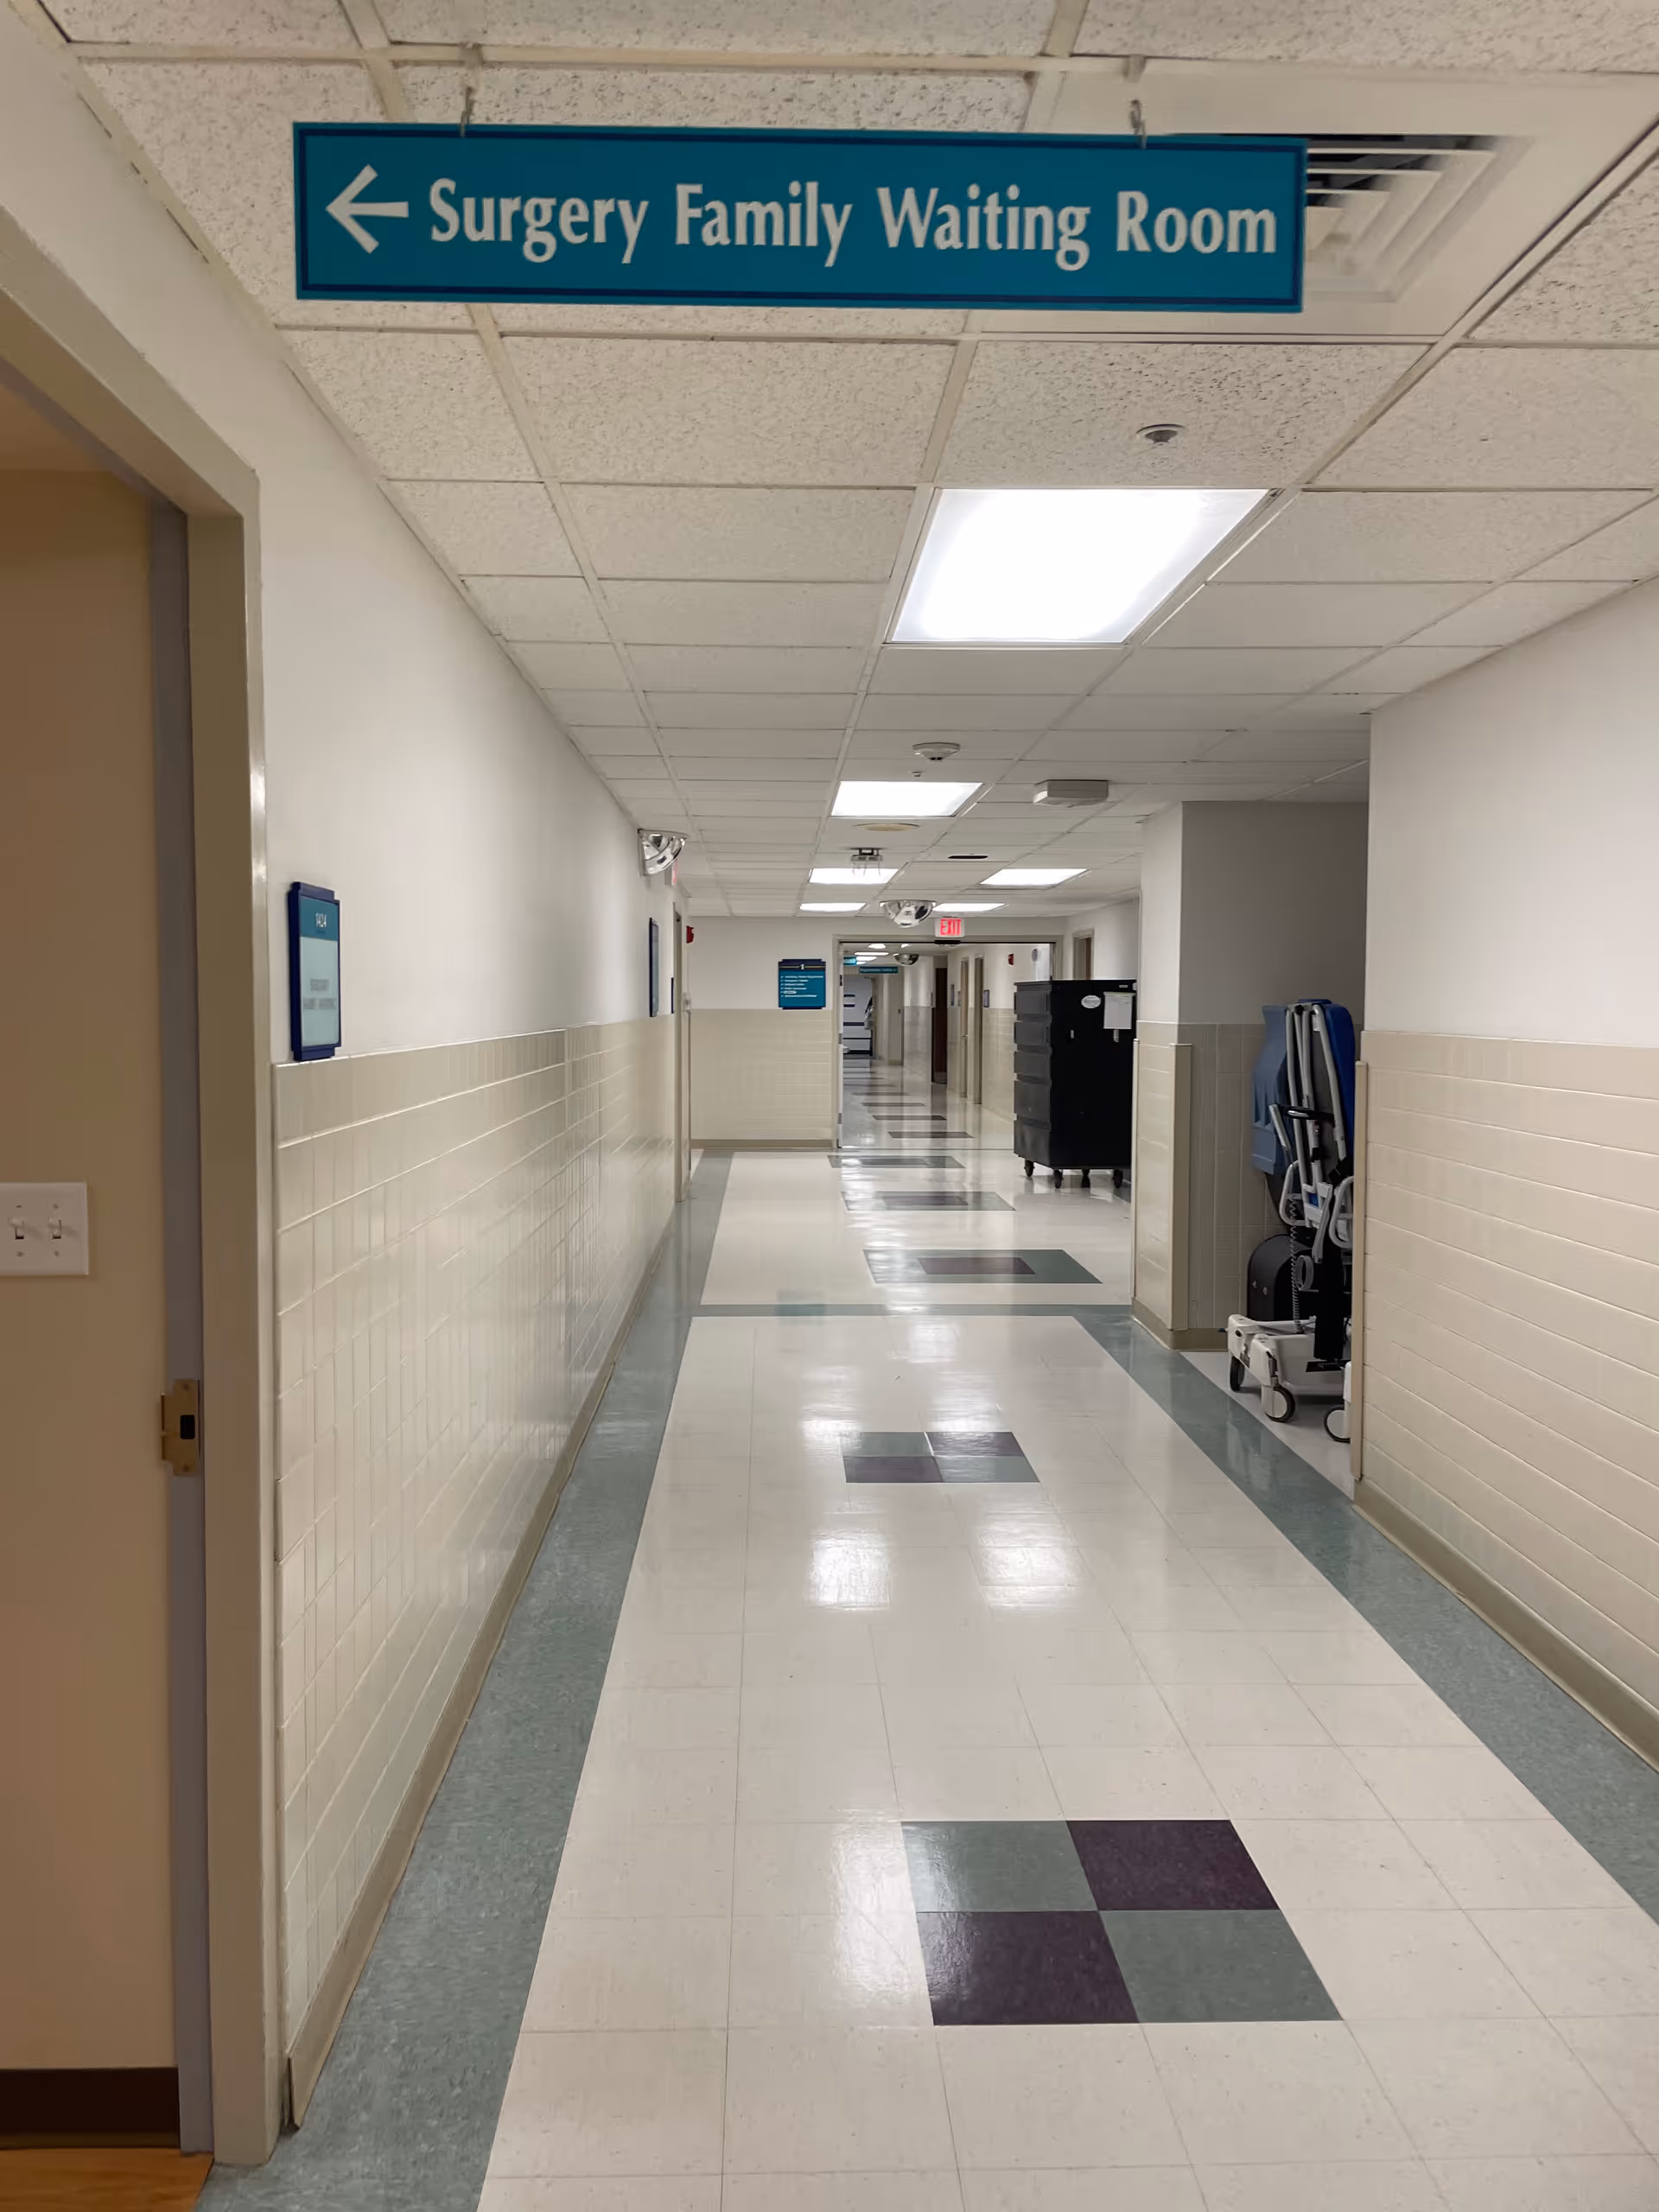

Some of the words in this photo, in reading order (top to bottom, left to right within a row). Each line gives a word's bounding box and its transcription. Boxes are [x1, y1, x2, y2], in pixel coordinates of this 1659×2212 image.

[429, 177, 650, 264] Surgery
[675, 181, 853, 268] Family
[876, 186, 1091, 272] Waiting
[1116, 190, 1277, 254] Room
[940, 918, 962, 936] EXIT
